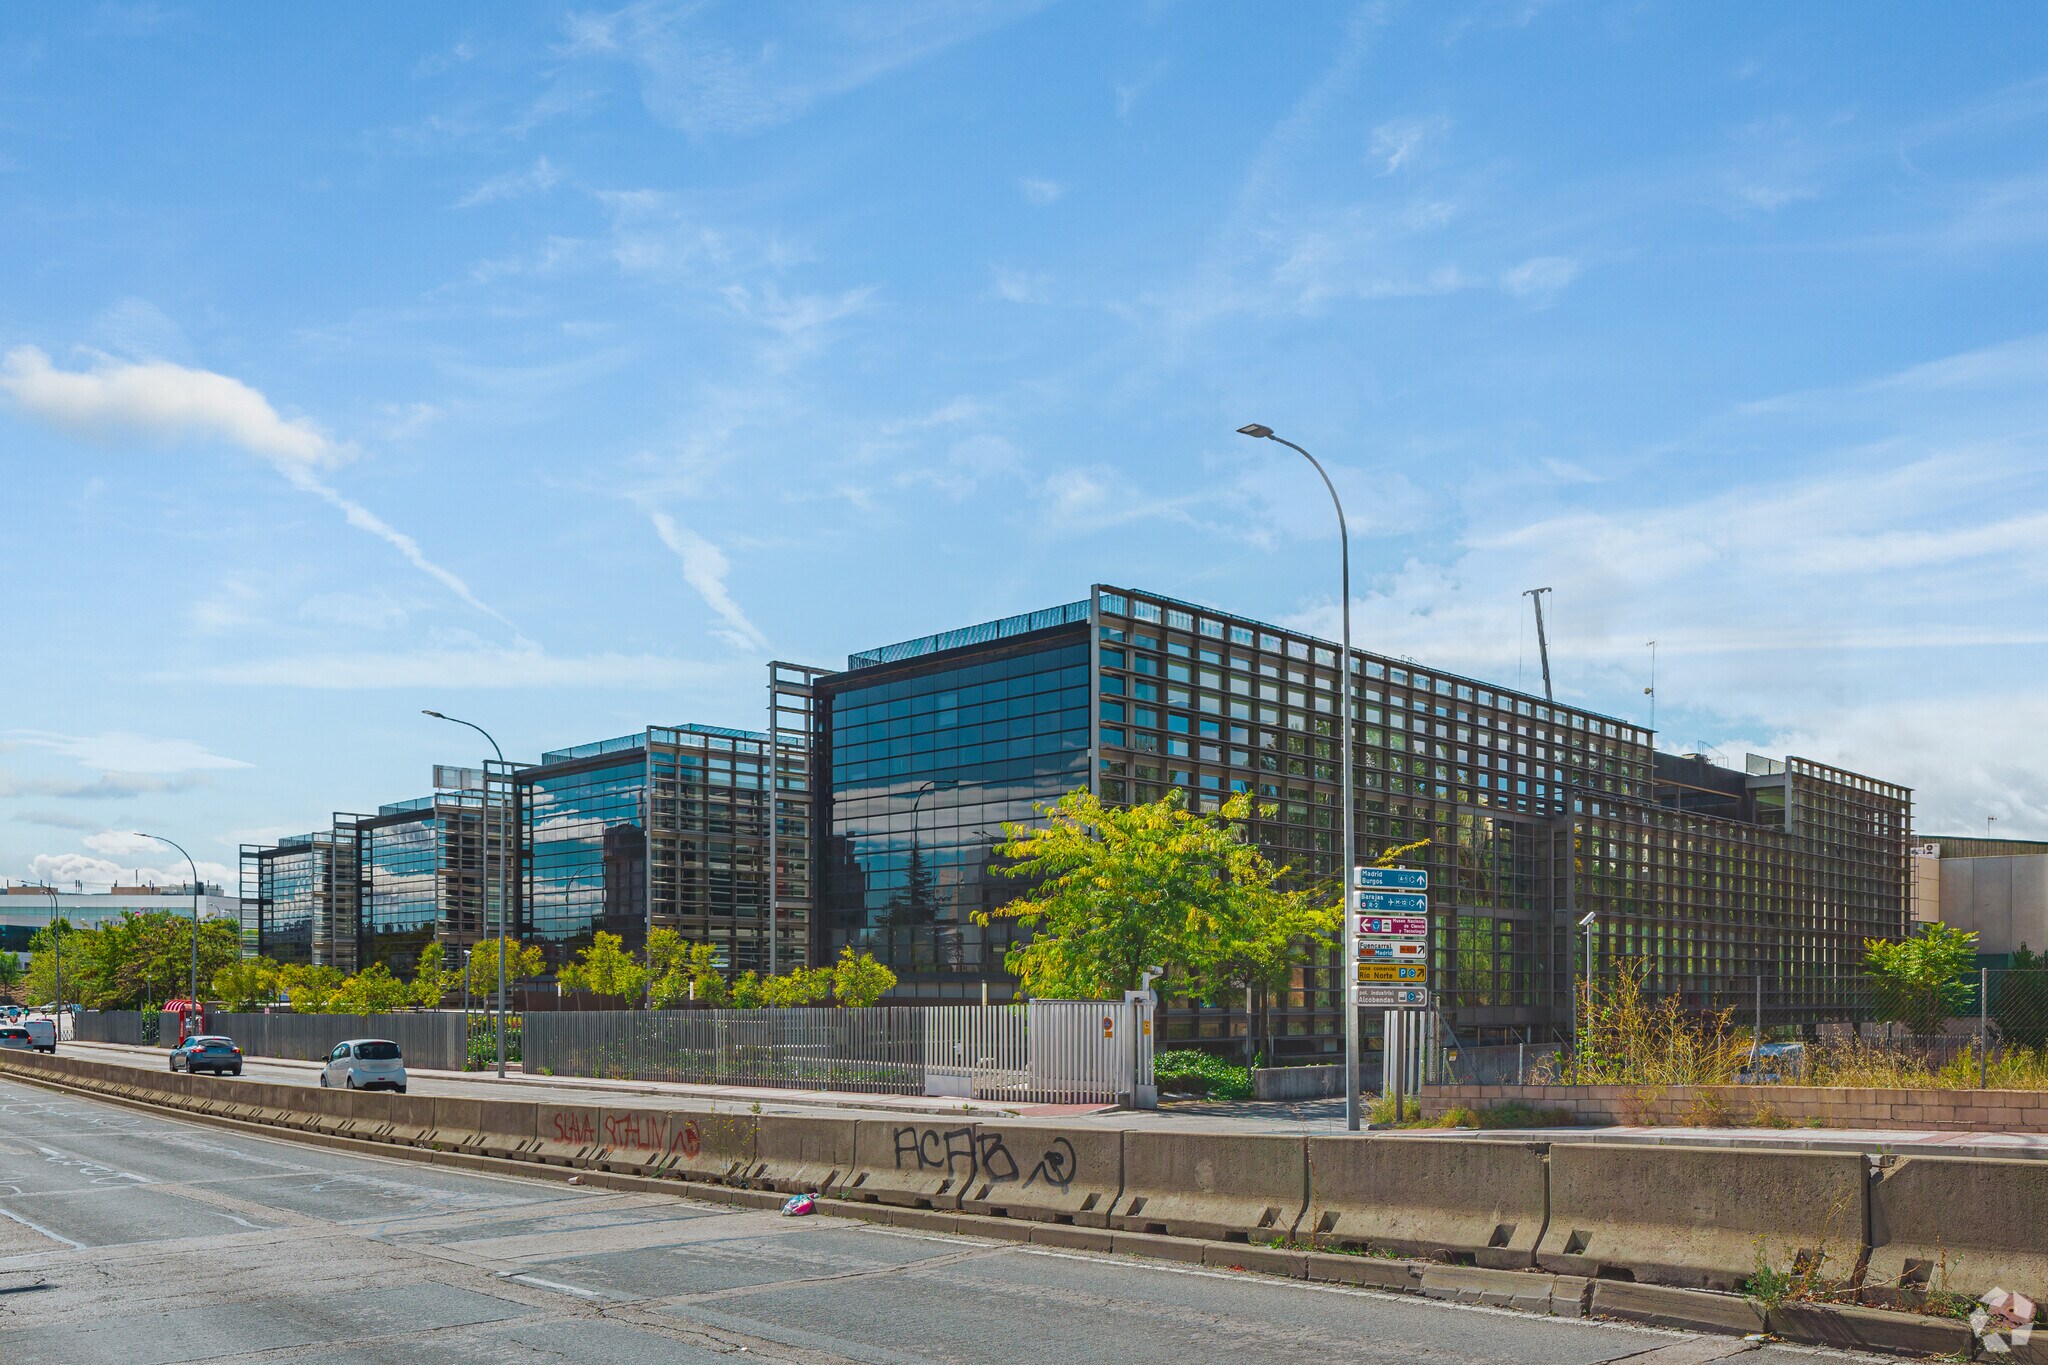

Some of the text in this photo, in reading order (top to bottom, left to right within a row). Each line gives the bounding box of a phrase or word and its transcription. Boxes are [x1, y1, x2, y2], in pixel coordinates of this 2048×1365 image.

[1361, 894, 1384, 902] Barajas
[553, 1111, 595, 1145] SLAVA
[893, 1126, 1020, 1183] ACAB
